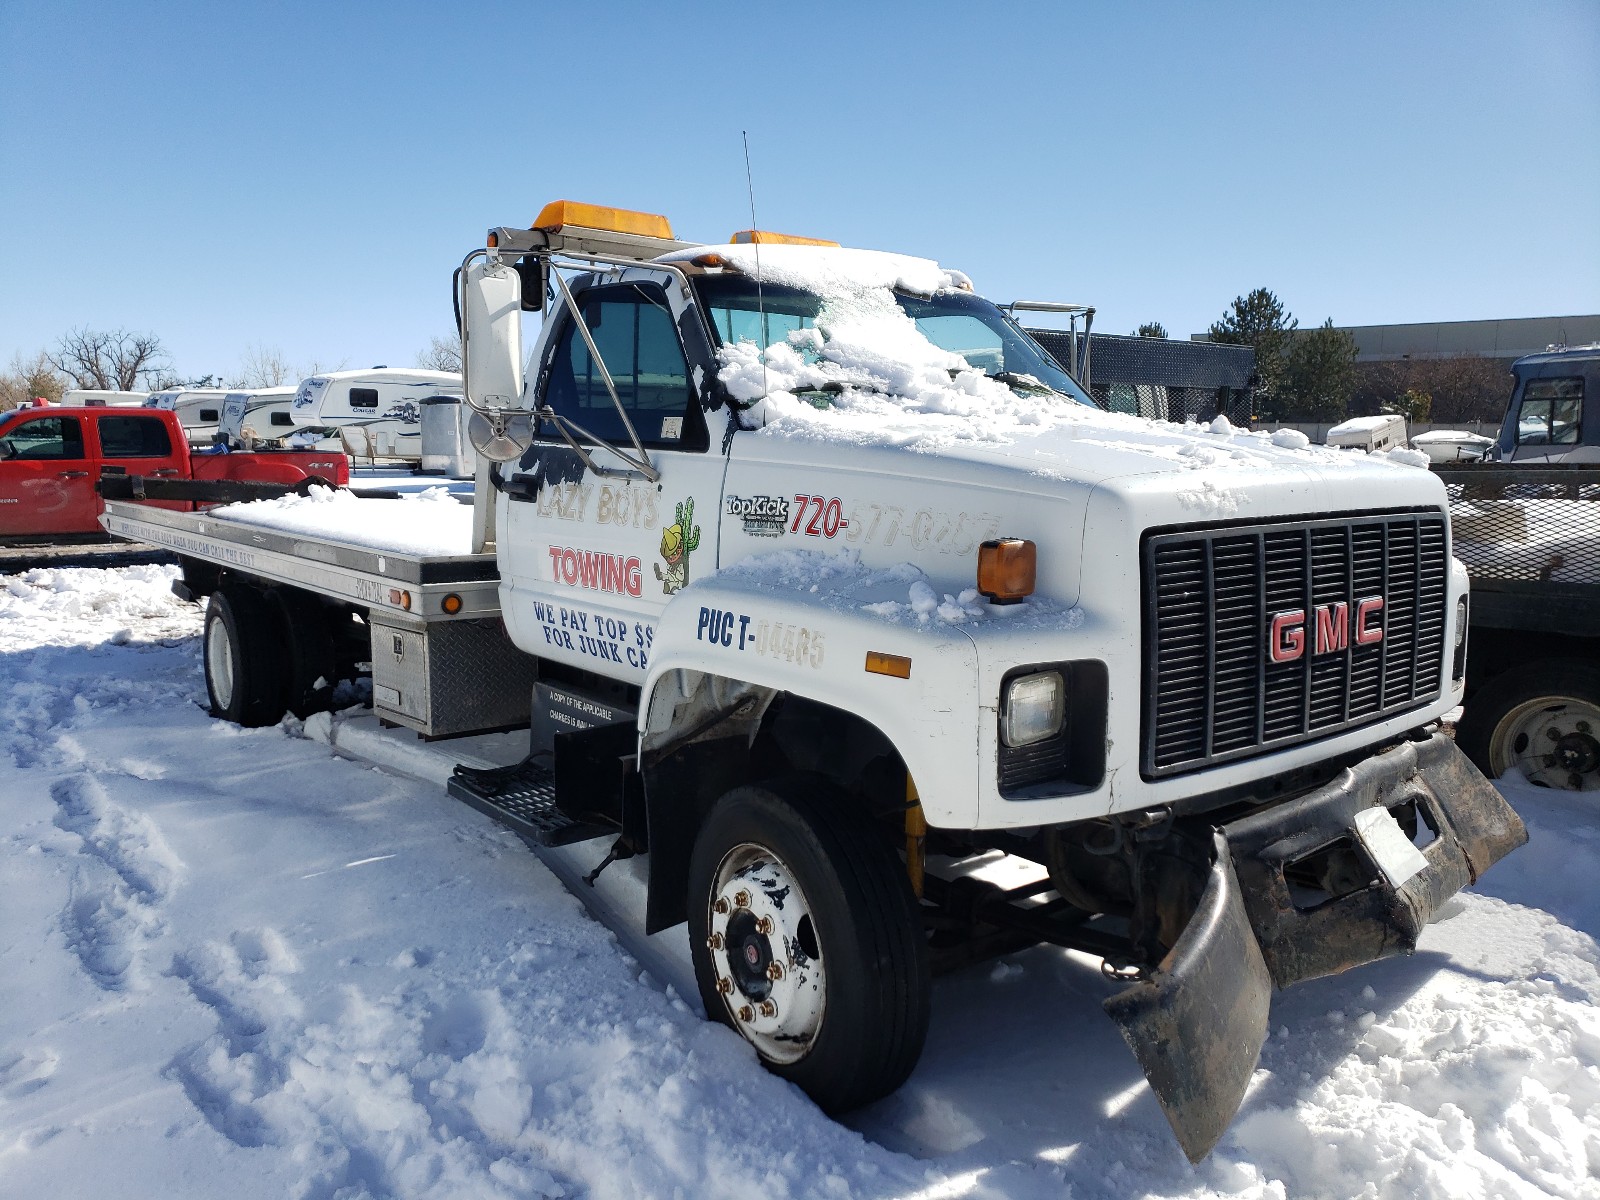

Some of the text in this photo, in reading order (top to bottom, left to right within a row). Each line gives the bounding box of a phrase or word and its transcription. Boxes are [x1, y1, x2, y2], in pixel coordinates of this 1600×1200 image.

[537, 480, 594, 522] LAZY
[726, 494, 790, 517] TopKick
[198, 541, 210, 555] CAN
[225, 548, 239, 562] THE
[239, 551, 255, 567] BEST
[549, 545, 643, 598] TOWING
[533, 601, 556, 624] WE
[560, 606, 588, 632] PAY
[594, 614, 628, 642] TOP
[1270, 595, 1384, 663] GMC
[543, 625, 575, 651] FOR
[578, 634, 624, 664] JUNK
[549, 690, 612, 721] A COPY OF THE APPLICABLE
[549, 709, 571, 725] CHARGES
[570, 717, 576, 727] IS
